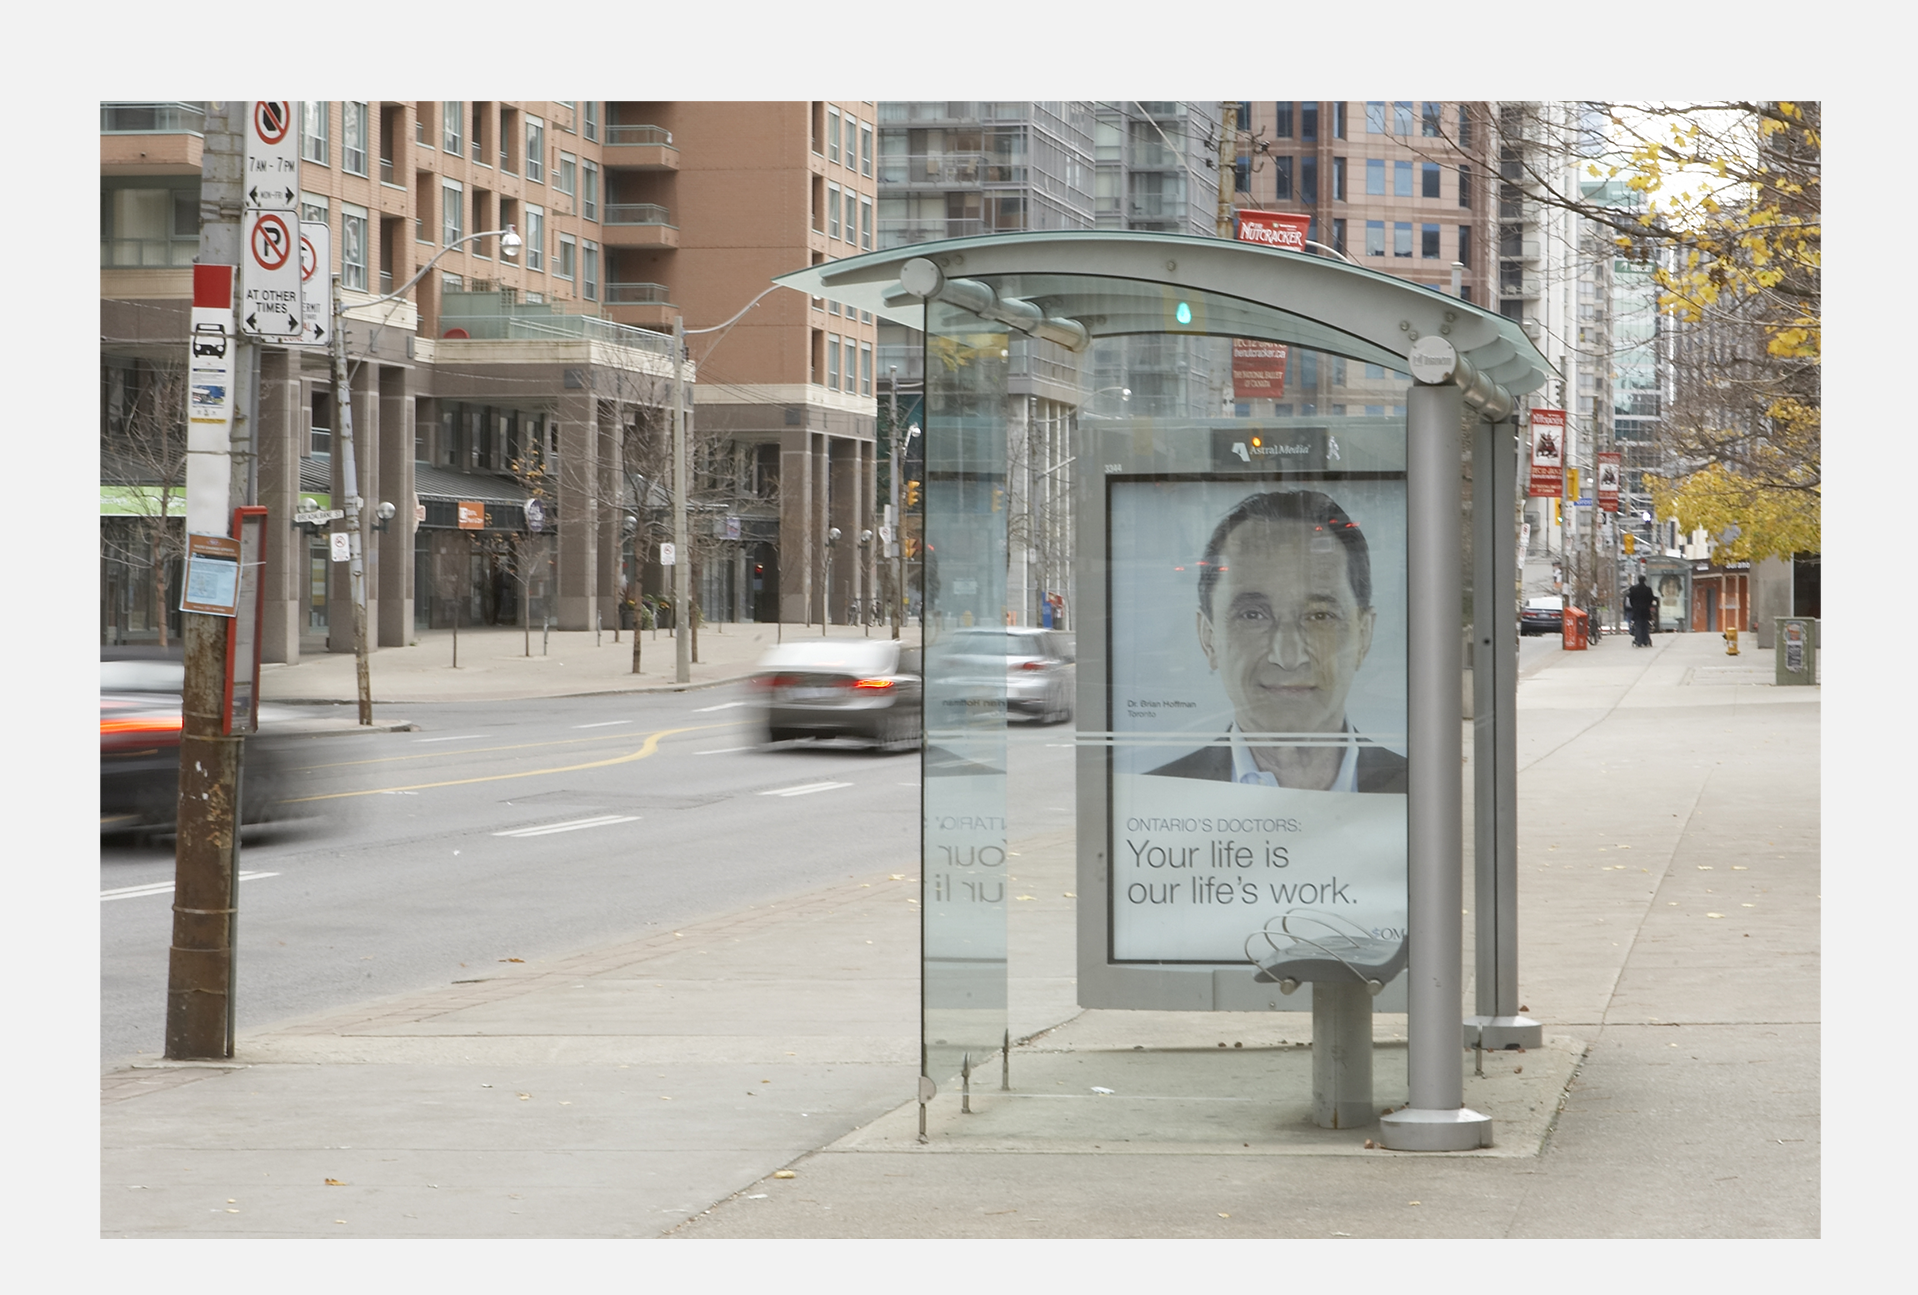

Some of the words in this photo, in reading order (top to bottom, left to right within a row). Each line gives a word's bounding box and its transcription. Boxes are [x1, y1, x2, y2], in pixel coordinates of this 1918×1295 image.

[1240, 222, 1303, 246] NUTCRACKER
[246, 289, 259, 300] AT
[262, 289, 297, 302] OTHER
[255, 302, 288, 314] TIMES
[302, 303, 321, 313] ERMIT
[1140, 700, 1161, 708] Brian
[1162, 700, 1197, 708] Hoffman
[1127, 710, 1157, 718] Toronto
[1127, 817, 1213, 832] ONTARIO'S
[1217, 818, 1302, 833] DOCTORS:
[1126, 839, 1200, 869] Your
[1211, 840, 1254, 869] life
[1265, 840, 1290, 869] is
[1128, 882, 1181, 904] our
[1192, 876, 1259, 905] life's
[1269, 876, 1358, 905] work.
